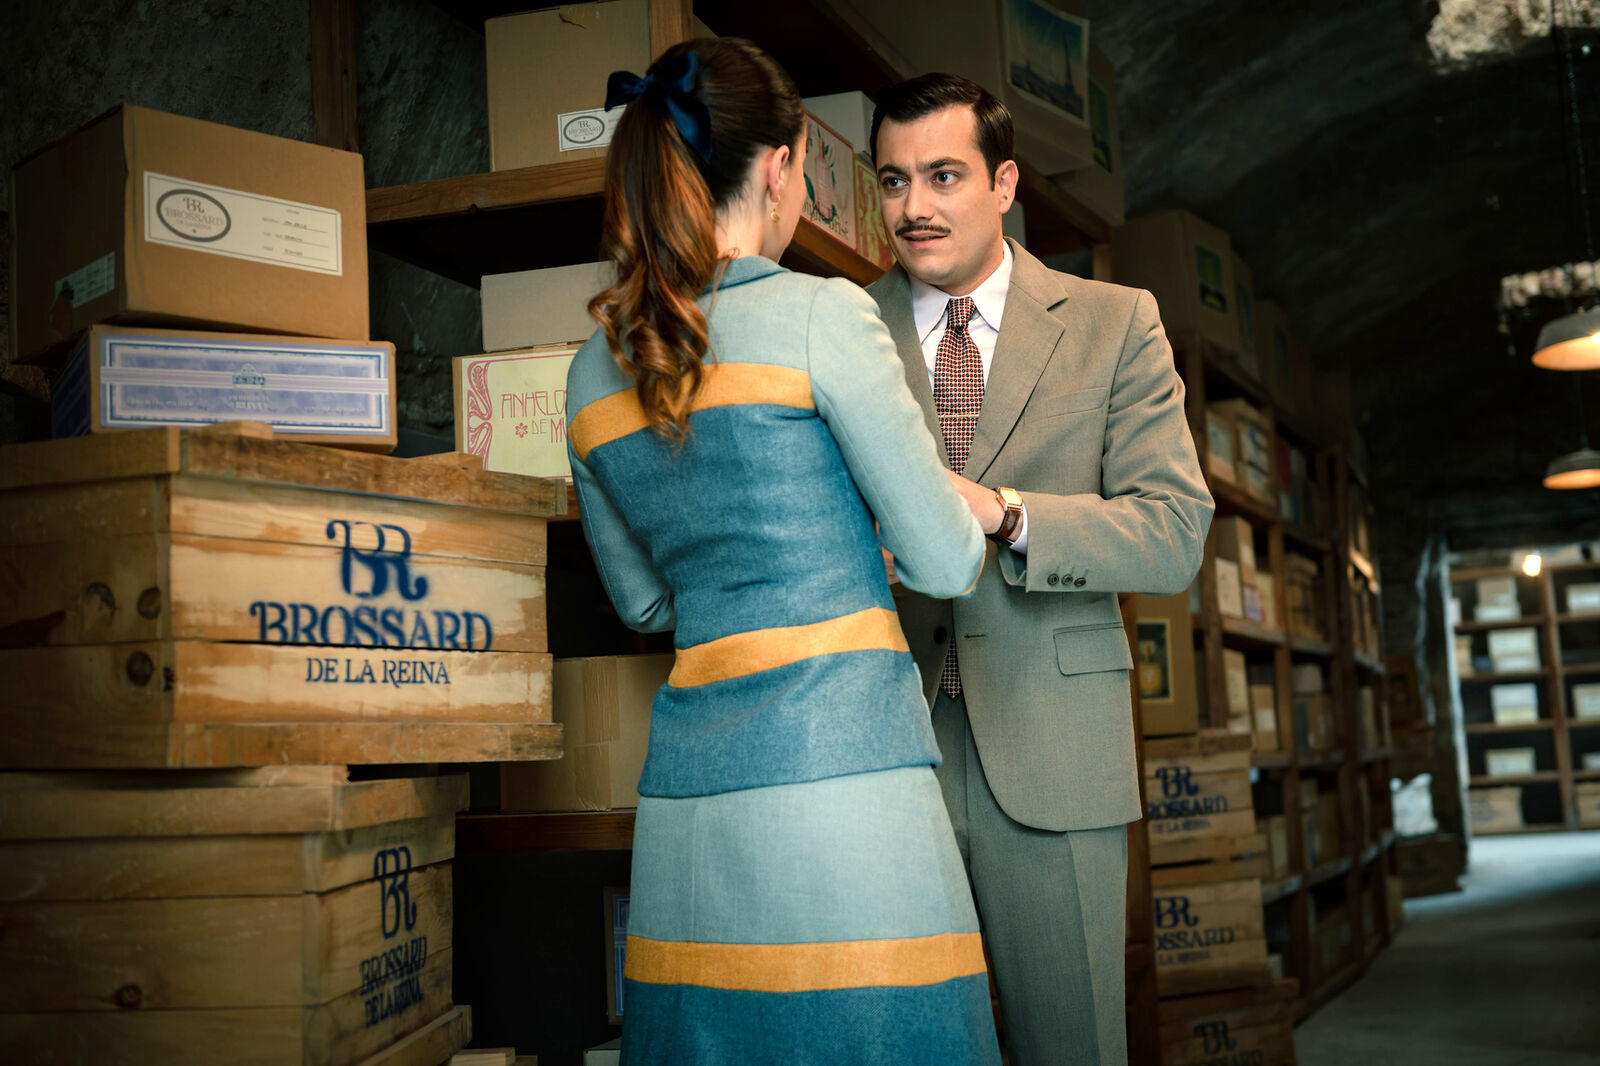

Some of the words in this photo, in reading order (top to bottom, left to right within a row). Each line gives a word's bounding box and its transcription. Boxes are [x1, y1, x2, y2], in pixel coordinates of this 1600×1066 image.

[531, 419, 547, 435] DE
[326, 519, 428, 601] BR
[249, 600, 494, 653] BROSSARD
[305, 658, 338, 683] DE
[343, 659, 376, 684] LA
[381, 660, 451, 688] REINA
[360, 936, 427, 996] BROSSARD
